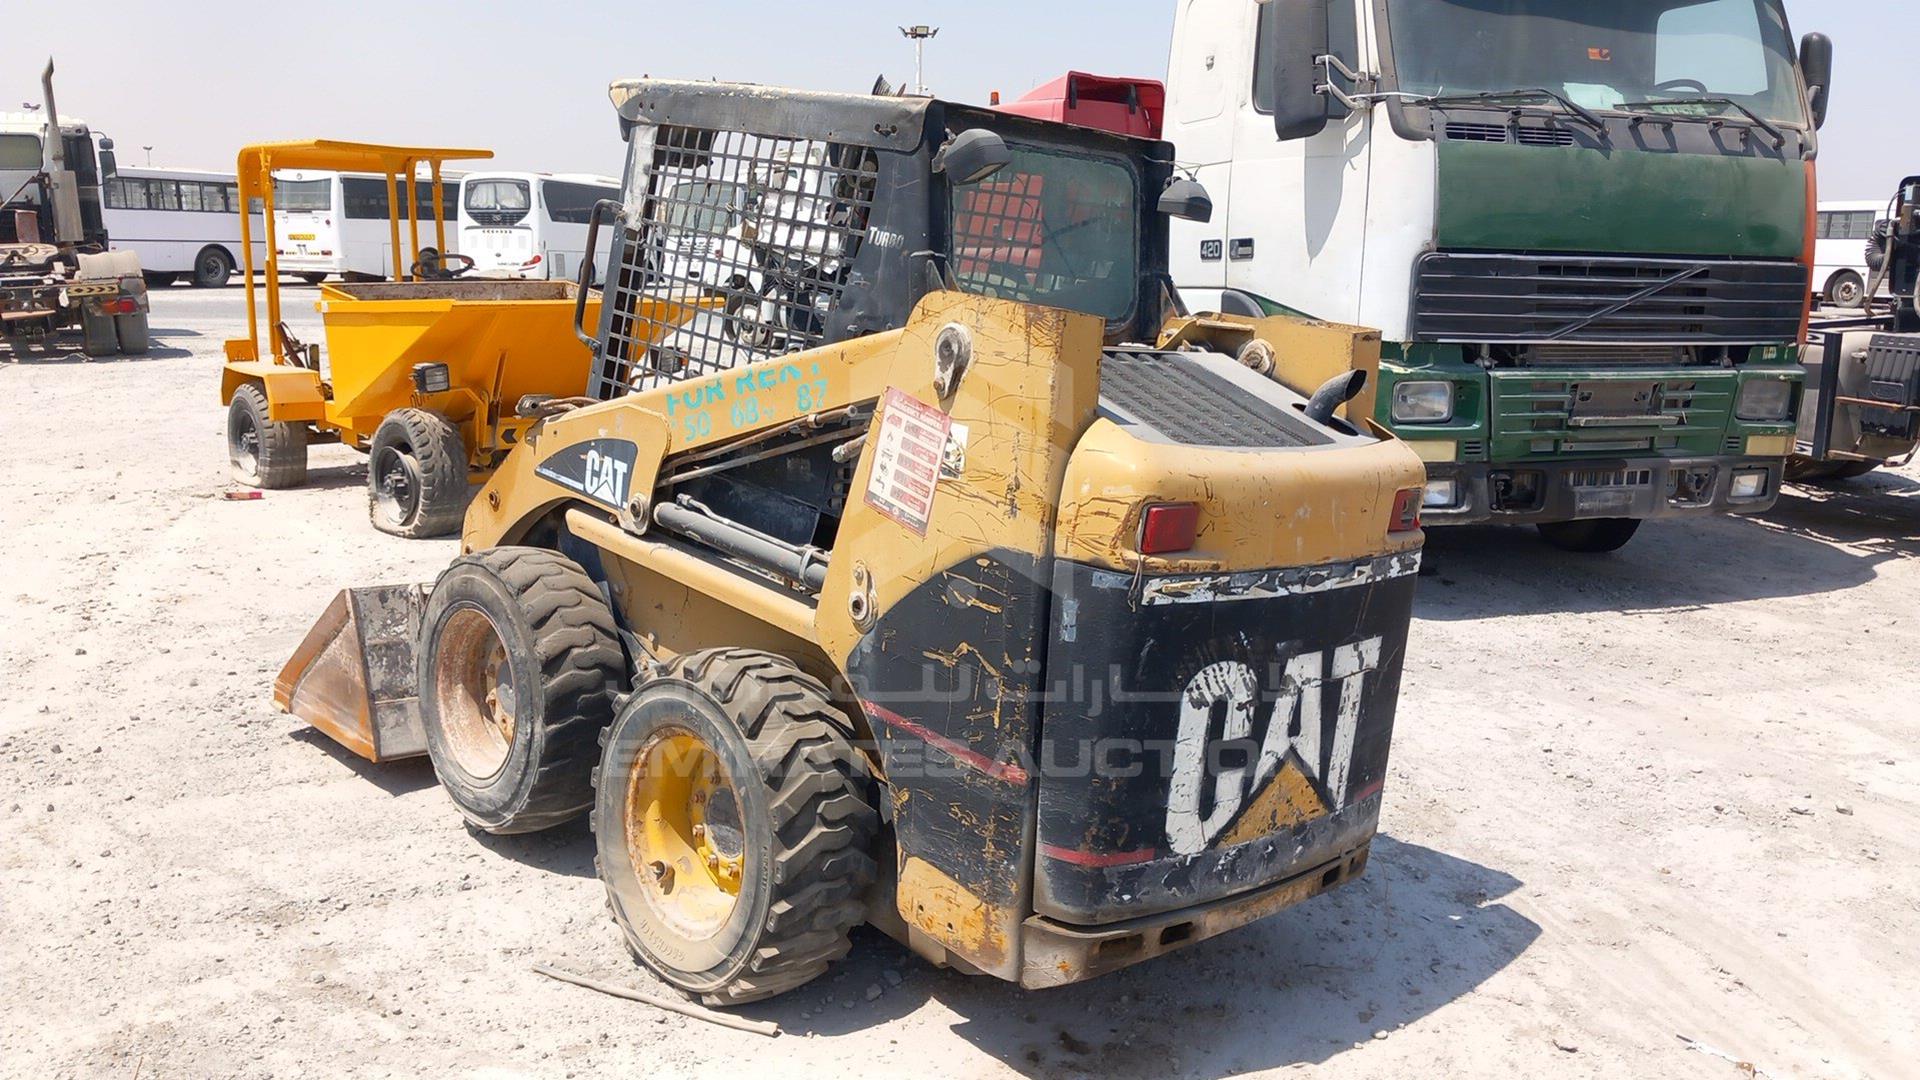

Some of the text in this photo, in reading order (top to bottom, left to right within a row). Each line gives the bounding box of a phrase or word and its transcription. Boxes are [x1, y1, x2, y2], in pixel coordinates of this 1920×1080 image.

[868, 226, 904, 249] TURBO
[1201, 242, 1220, 257] 420
[735, 362, 820, 396] REN
[584, 449, 628, 508] CAT
[1165, 636, 1383, 856] CAT
